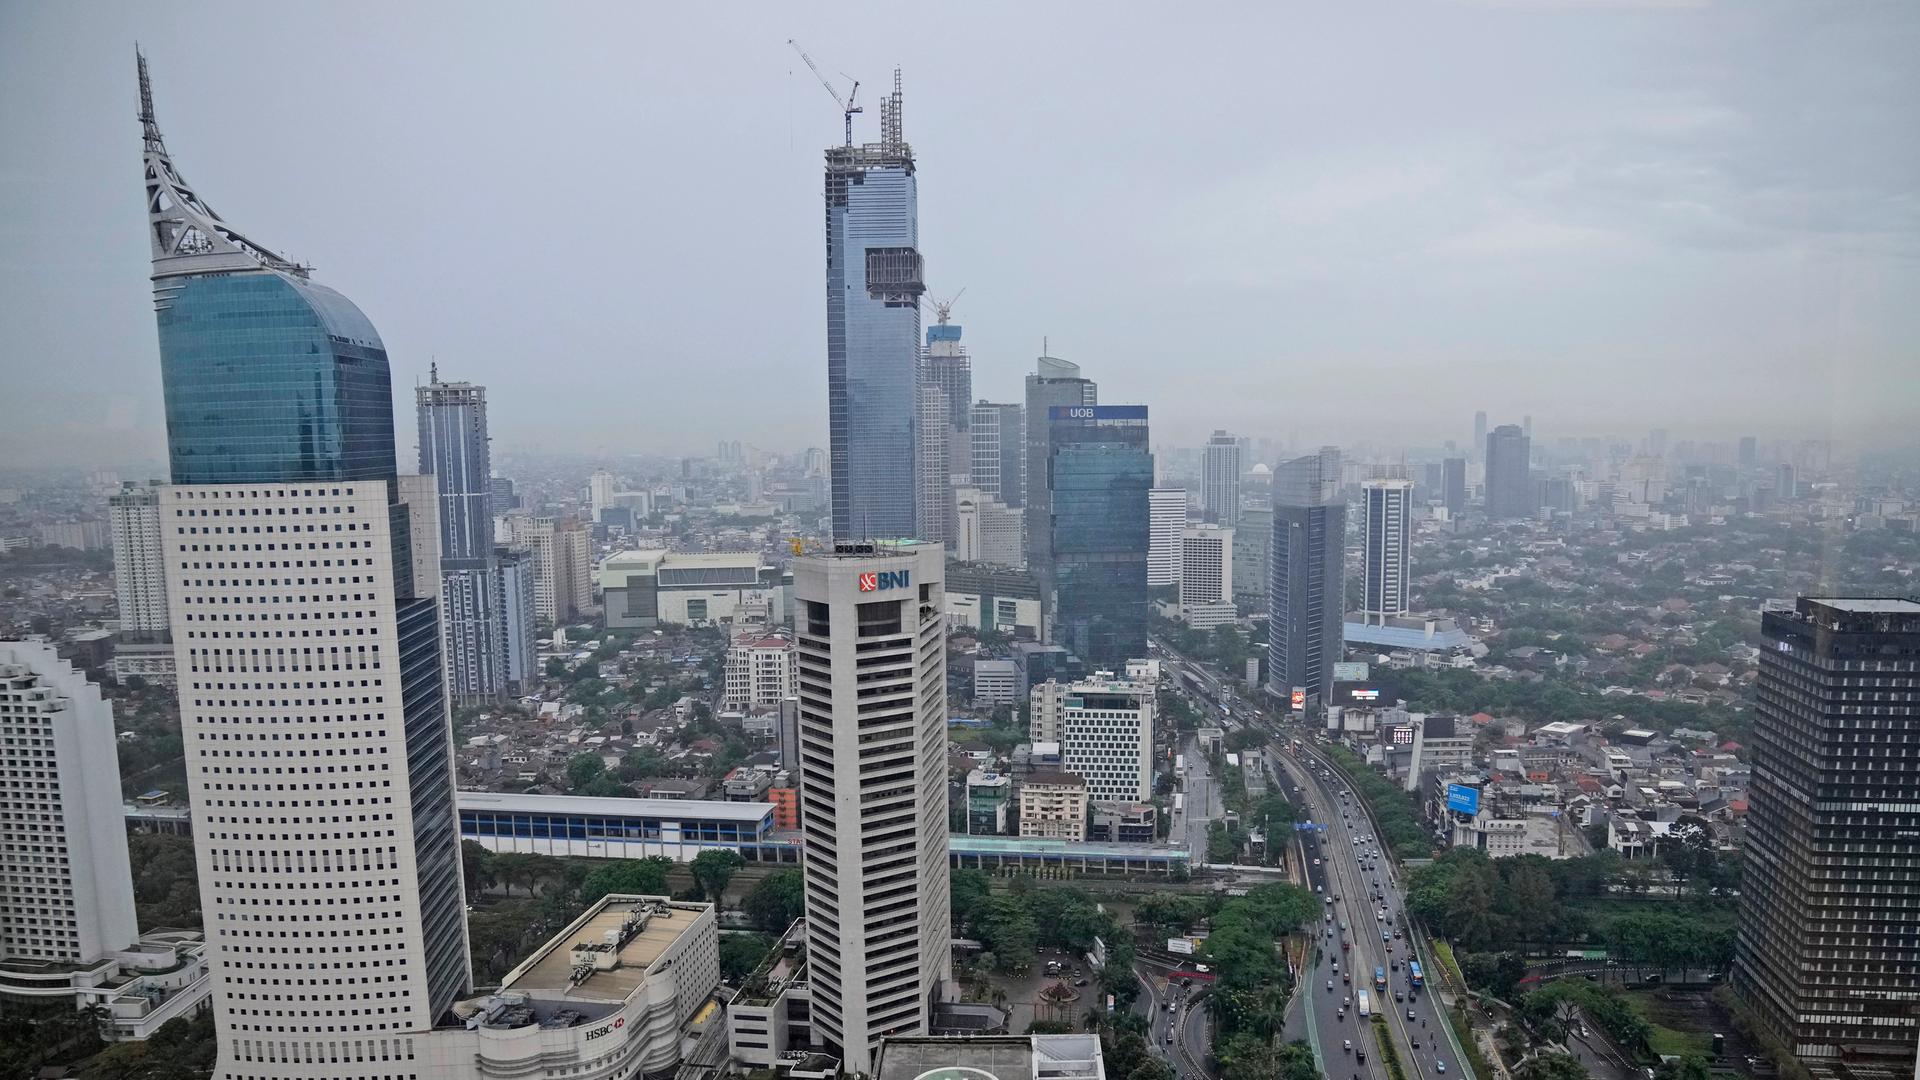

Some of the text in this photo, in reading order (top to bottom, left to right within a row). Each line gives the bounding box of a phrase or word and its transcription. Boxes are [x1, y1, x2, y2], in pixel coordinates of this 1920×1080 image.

[1070, 408, 1094, 418] UOB
[878, 570, 909, 590] BNI
[585, 1024, 613, 1041] HSBC
